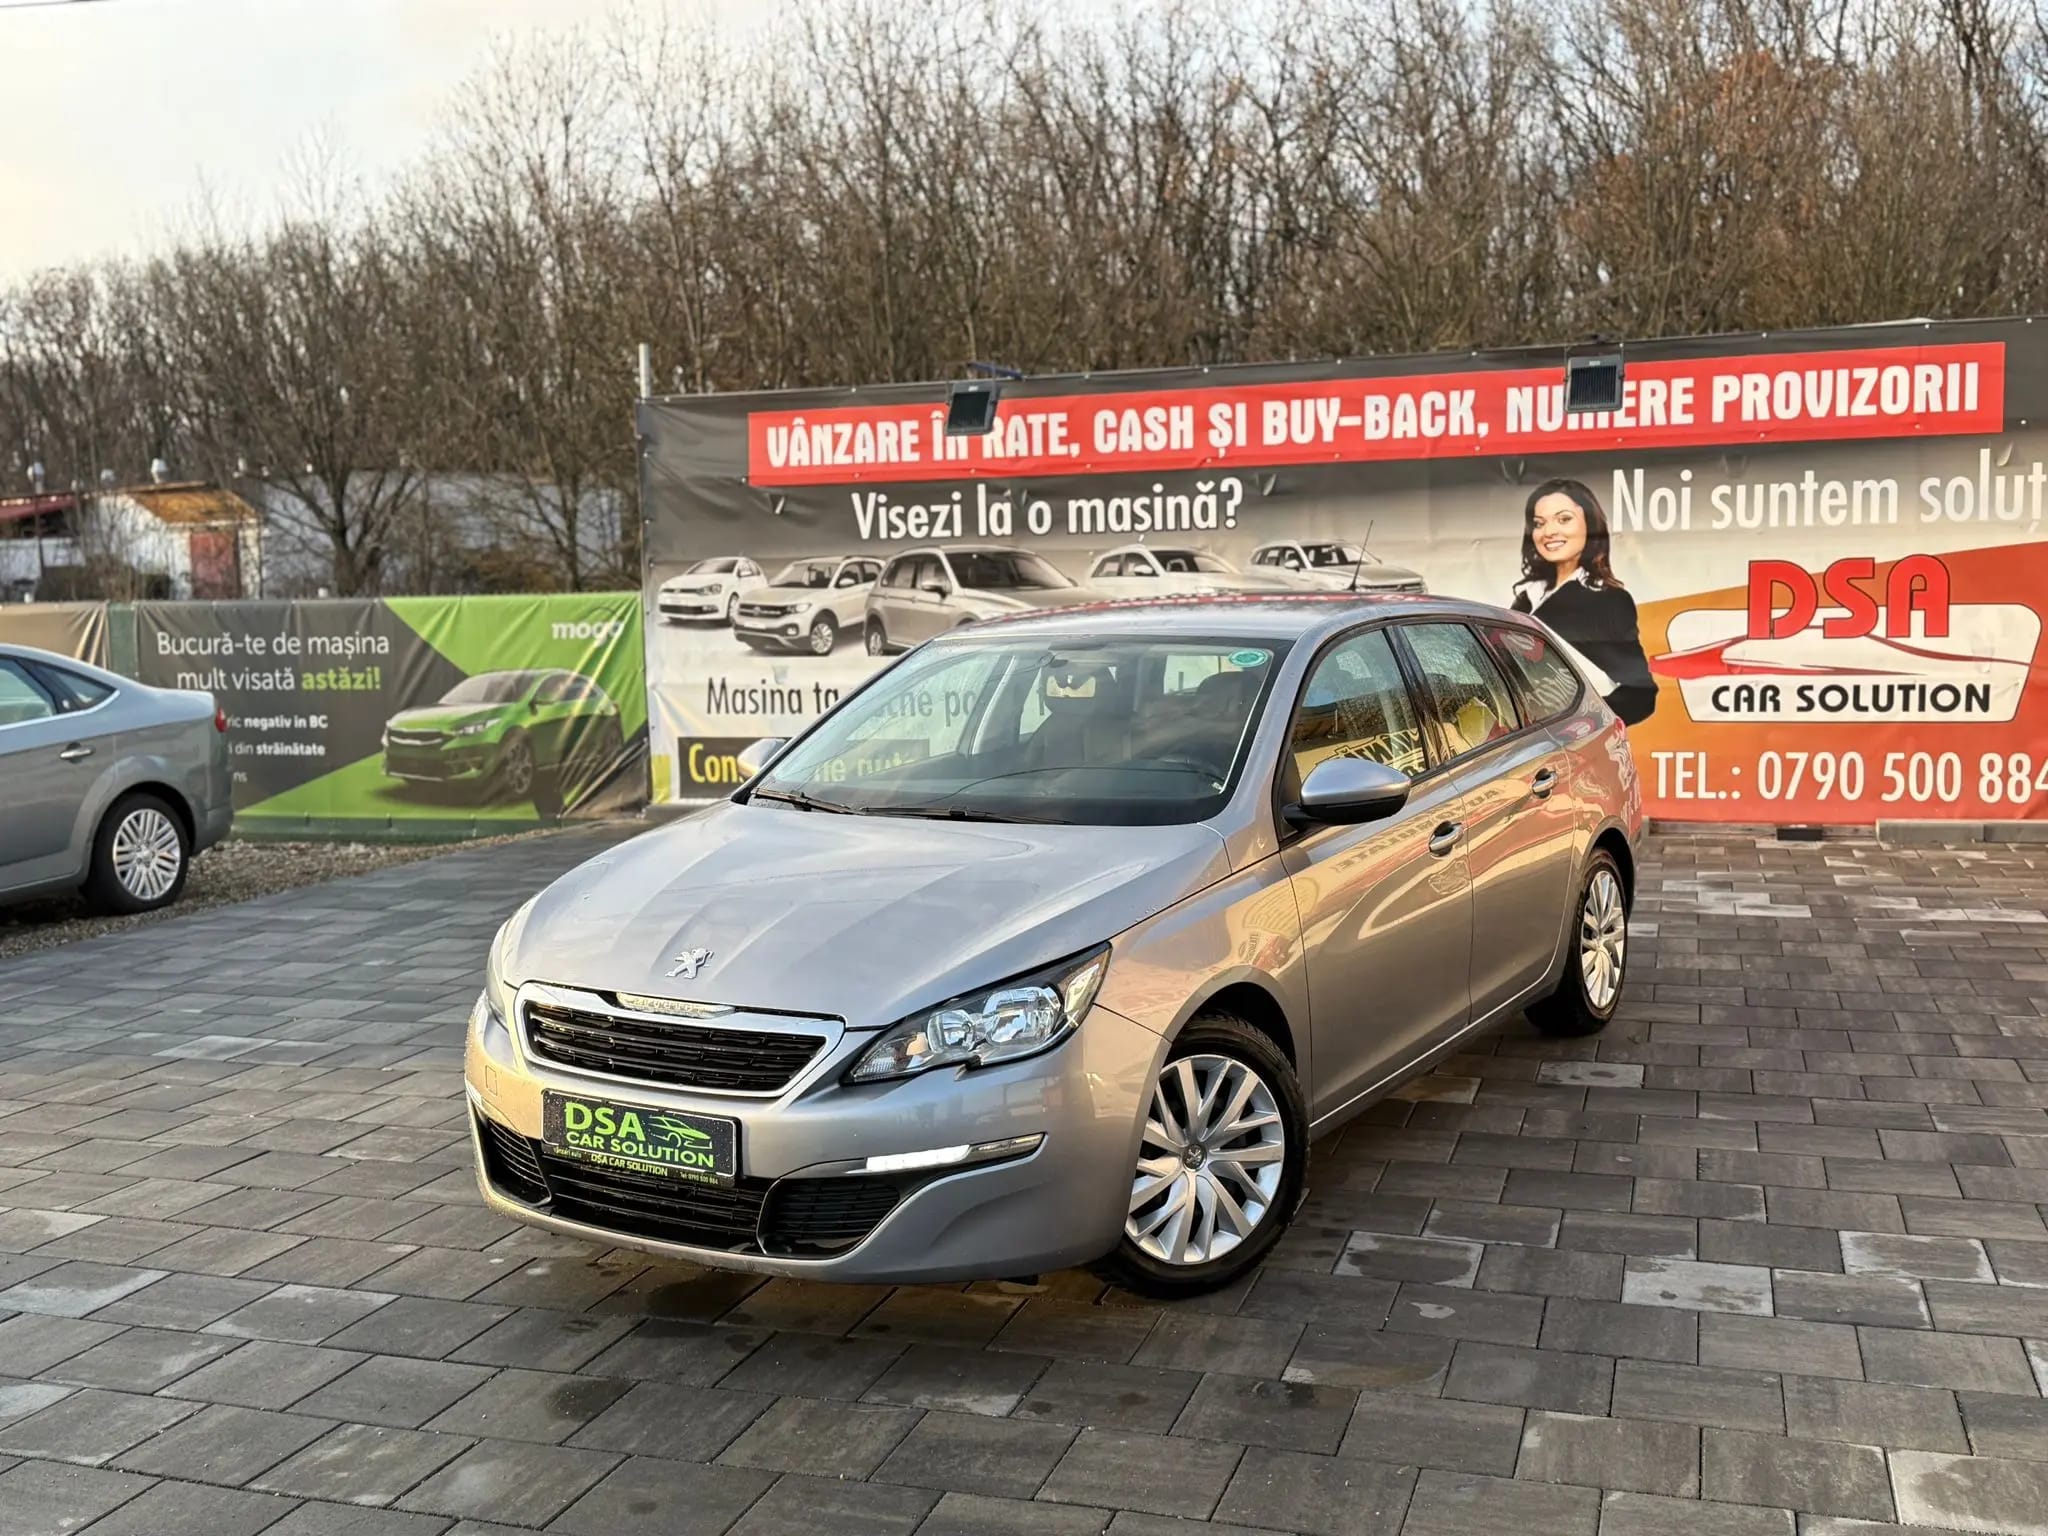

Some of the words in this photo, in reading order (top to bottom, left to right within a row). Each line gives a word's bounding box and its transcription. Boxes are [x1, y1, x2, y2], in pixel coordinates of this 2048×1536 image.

[767, 417, 920, 468] VÂNZARE
[982, 412, 1081, 458] RATE,
[1093, 405, 1194, 454] CASH
[1207, 402, 1247, 457] ȘI
[1712, 362, 1978, 423] PROVIZORII
[1613, 468, 1692, 533] Noi
[1711, 469, 1898, 530] suntem
[1920, 447, 2048, 534] soluț
[851, 490, 962, 540] Visezi
[977, 484, 1012, 536] la
[1027, 501, 1052, 535] o
[1748, 553, 1950, 640] DSA
[157, 631, 266, 655] Bucură-te
[272, 632, 301, 655] de
[308, 631, 389, 660] mașina
[177, 667, 227, 690] mult
[232, 667, 296, 690] visată
[301, 666, 382, 690] astăzi!
[706, 677, 802, 716] Masina
[1711, 684, 1780, 712] CAR
[1797, 683, 1990, 713] SOLUTION
[244, 715, 292, 731] negativ
[309, 715, 328, 728] BC
[1651, 750, 1741, 800] TEL.:
[1757, 750, 1865, 801] 0790
[1881, 751, 1962, 802] 500
[564, 1102, 646, 1141] DSA
[566, 1131, 604, 1149] CAR
[610, 1139, 714, 1168] SOLUTION
[591, 1153, 609, 1165] DSA
[608, 1156, 626, 1169] CAR
[626, 1159, 668, 1177] SOLUTION
